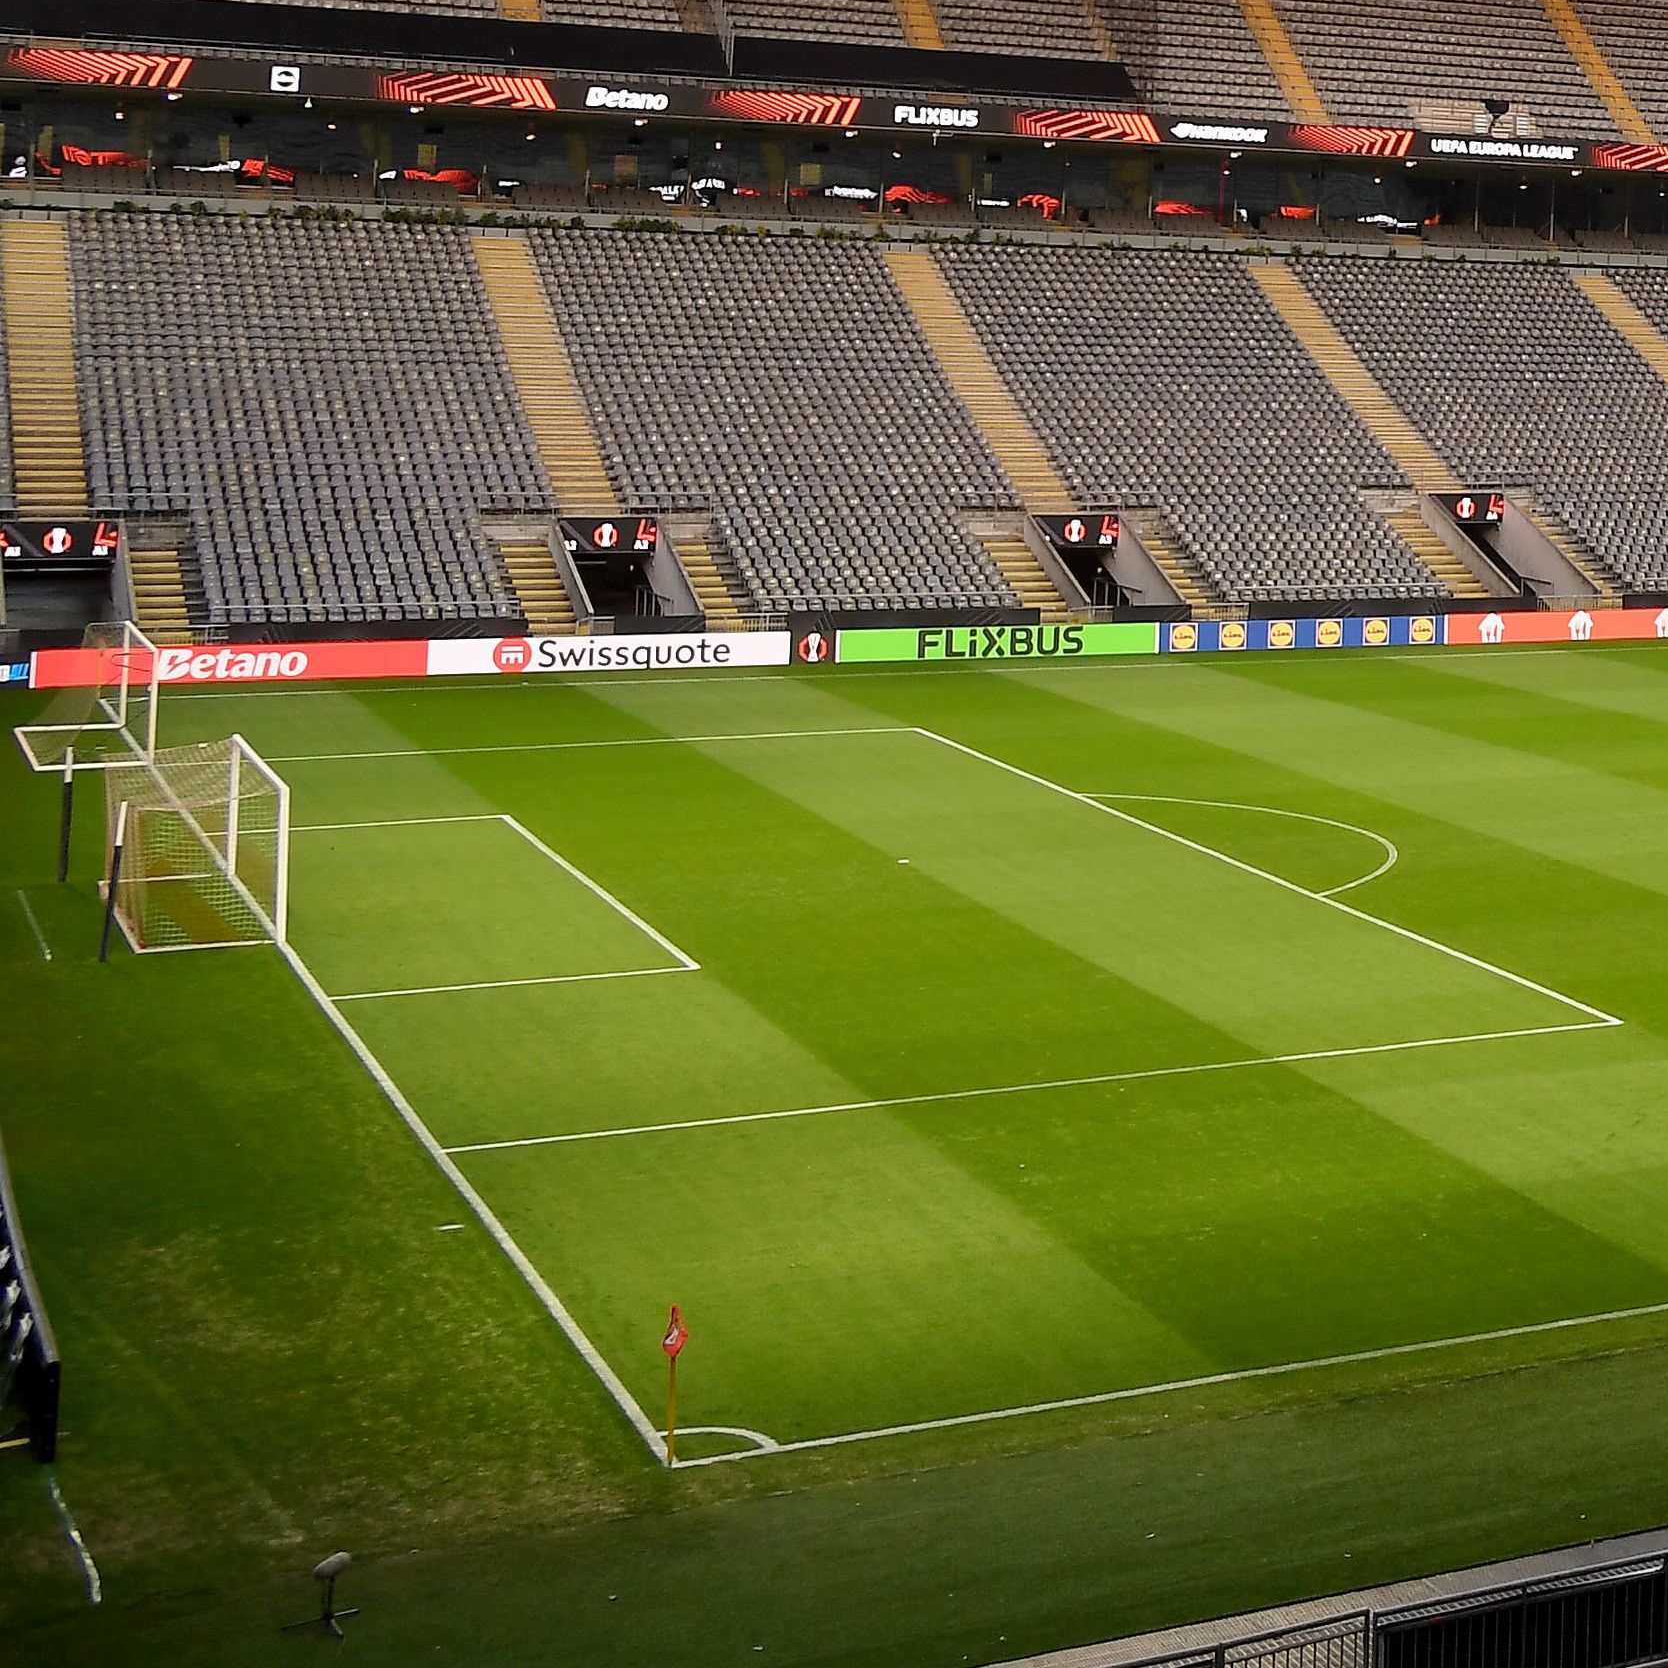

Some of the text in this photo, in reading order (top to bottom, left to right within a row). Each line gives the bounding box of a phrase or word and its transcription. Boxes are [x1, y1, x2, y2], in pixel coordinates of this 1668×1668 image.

[585, 86, 669, 112] Betano
[1431, 138, 1576, 160] UEFA EUROPA LEAGUE
[158, 648, 308, 681] Betano
[538, 639, 731, 670] Swissquote
